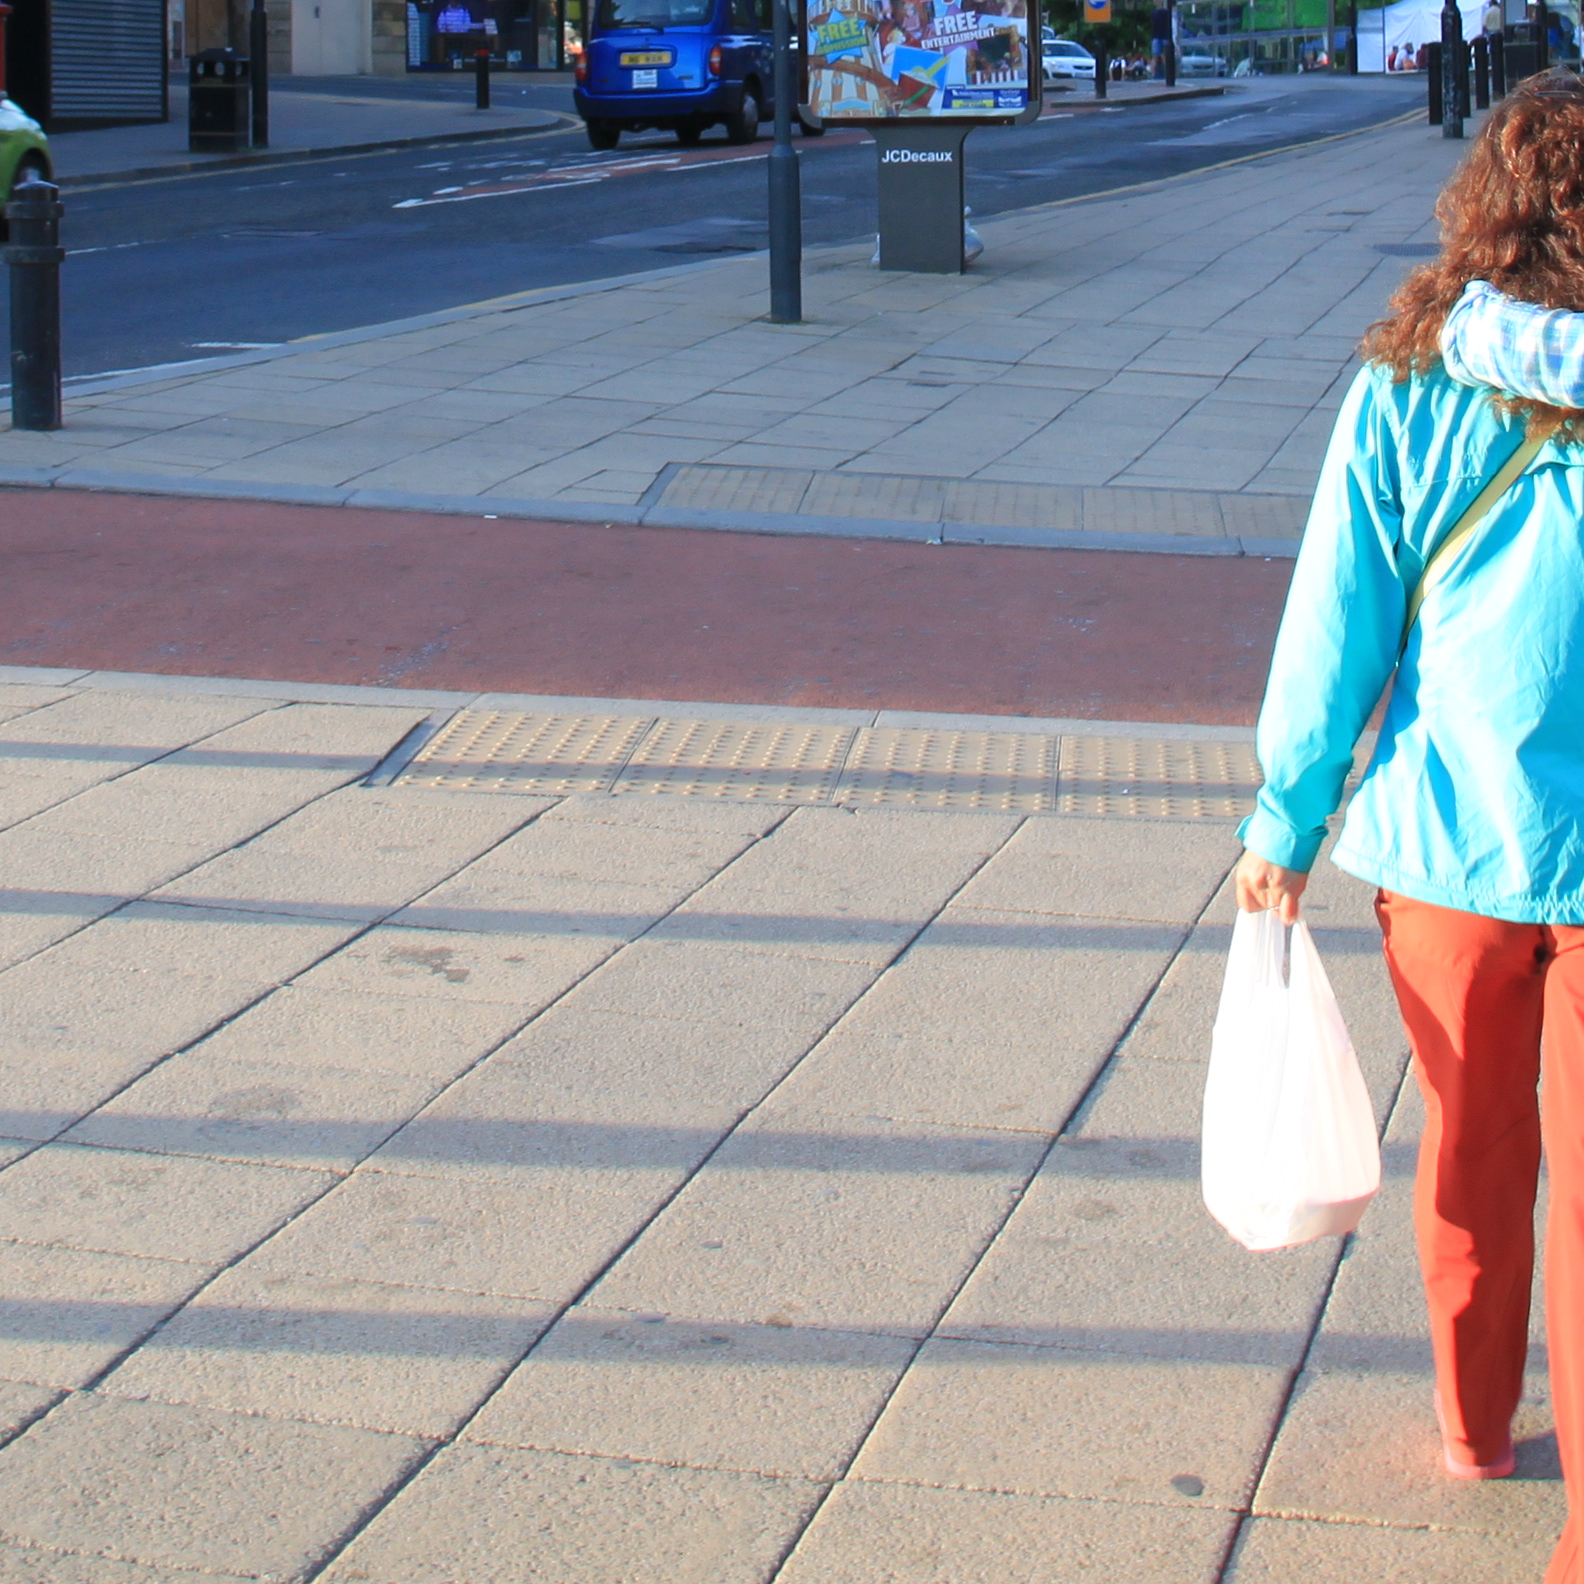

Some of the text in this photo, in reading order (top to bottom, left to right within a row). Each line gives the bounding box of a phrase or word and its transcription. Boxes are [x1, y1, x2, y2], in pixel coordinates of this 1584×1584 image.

[817, 17, 862, 43] FREE
[932, 10, 979, 36] FREE
[921, 26, 996, 50] ENTERTAINMENT
[881, 149, 953, 163] JCDecaux
